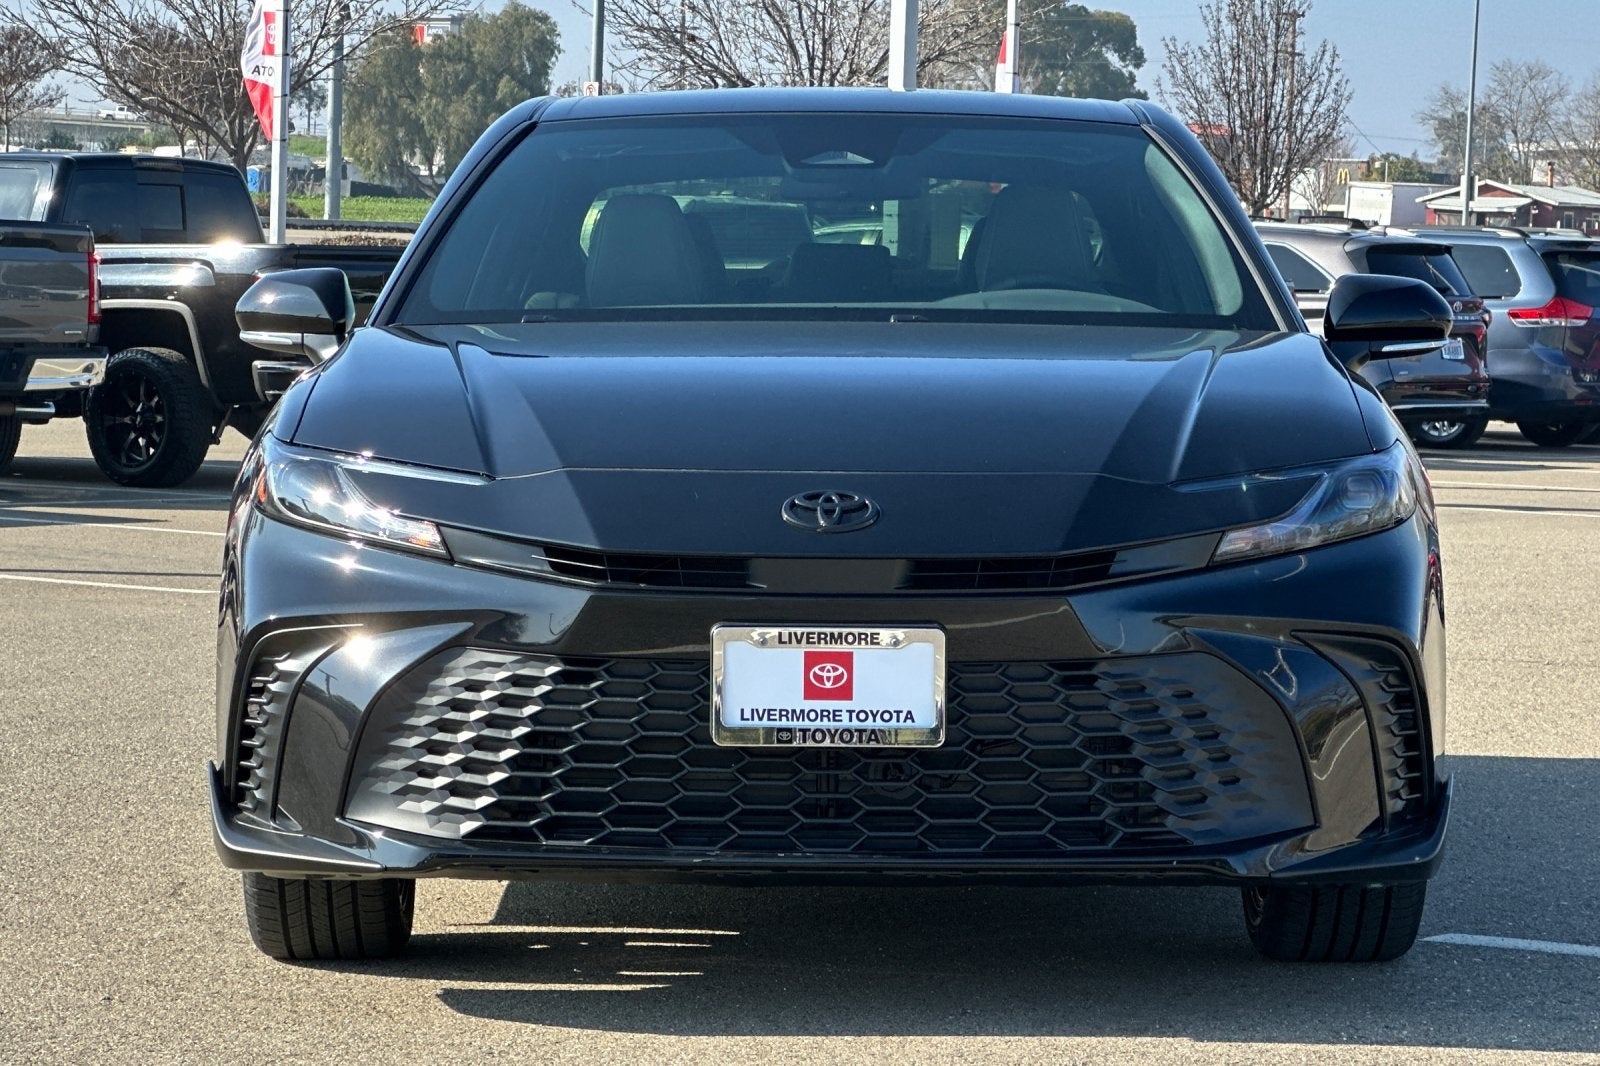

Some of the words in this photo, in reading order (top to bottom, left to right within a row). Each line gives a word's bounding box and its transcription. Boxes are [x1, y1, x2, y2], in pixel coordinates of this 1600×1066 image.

[778, 632, 880, 645] LIVERMORE
[740, 708, 843, 723] LIVERMORE
[846, 709, 915, 723] TOYOTA
[798, 728, 880, 744] TOYOTA
